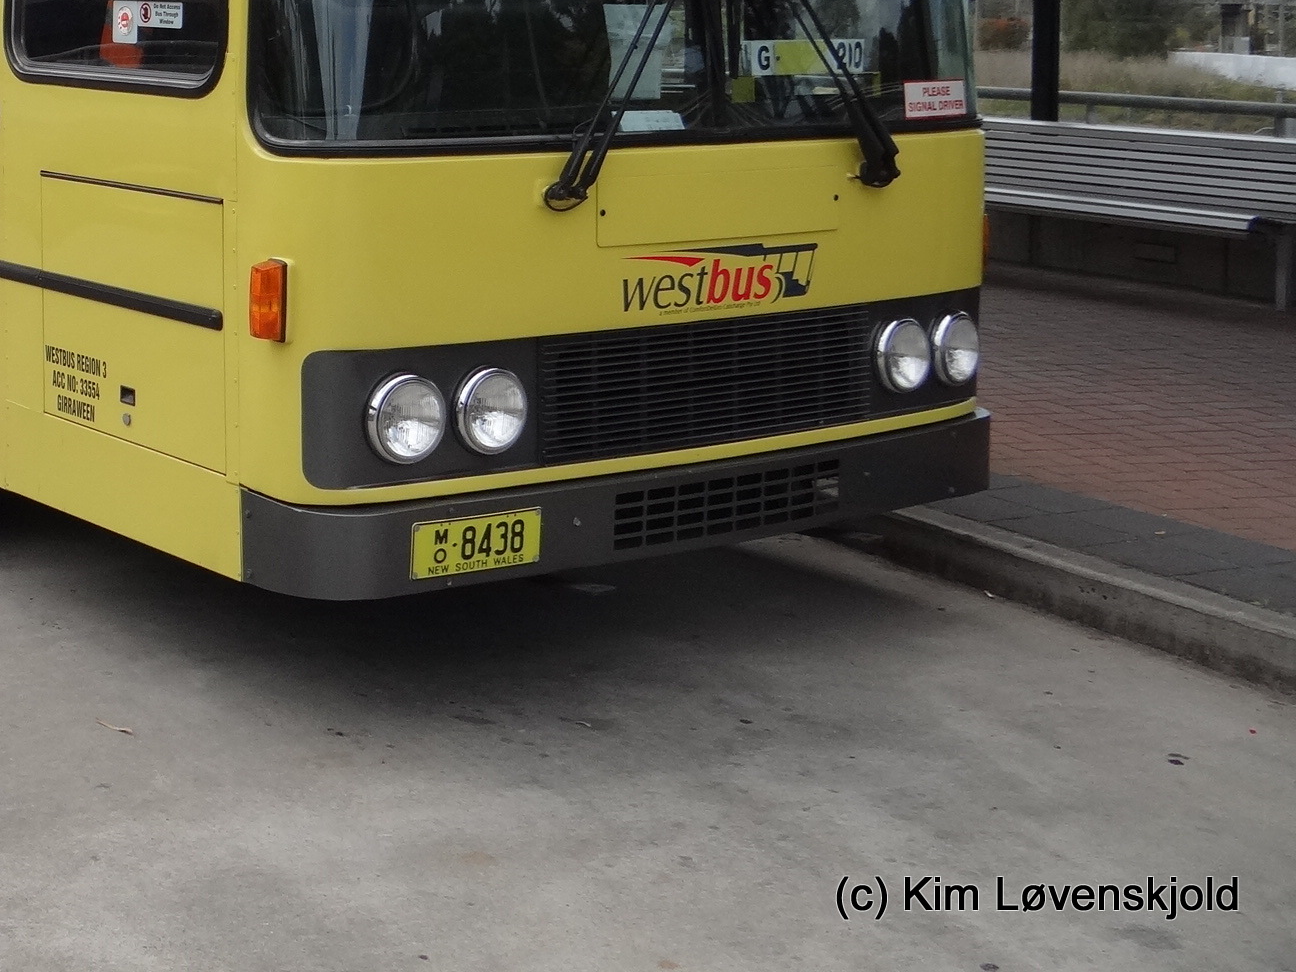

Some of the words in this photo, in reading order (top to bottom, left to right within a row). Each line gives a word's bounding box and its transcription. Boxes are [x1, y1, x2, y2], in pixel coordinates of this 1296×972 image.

[163, 11, 179, 19] Through
[757, 45, 771, 71] G
[922, 86, 950, 96] PLEASE
[908, 101, 937, 112] SIGNAL
[938, 99, 963, 111] DRIVER
[622, 259, 774, 313] westbus
[45, 344, 75, 369] WESTBUS
[76, 353, 101, 377] REGION
[102, 361, 107, 378] 3
[52, 370, 65, 389] ACC
[66, 373, 78, 394] NO:
[79, 378, 100, 400] 33554
[57, 394, 95, 422] GIRRAWEEN
[434, 528, 448, 545] M
[460, 519, 525, 560] 8438
[428, 565, 450, 575] NEW
[455, 560, 488, 572] SOUTH
[493, 553, 524, 565] WALES
